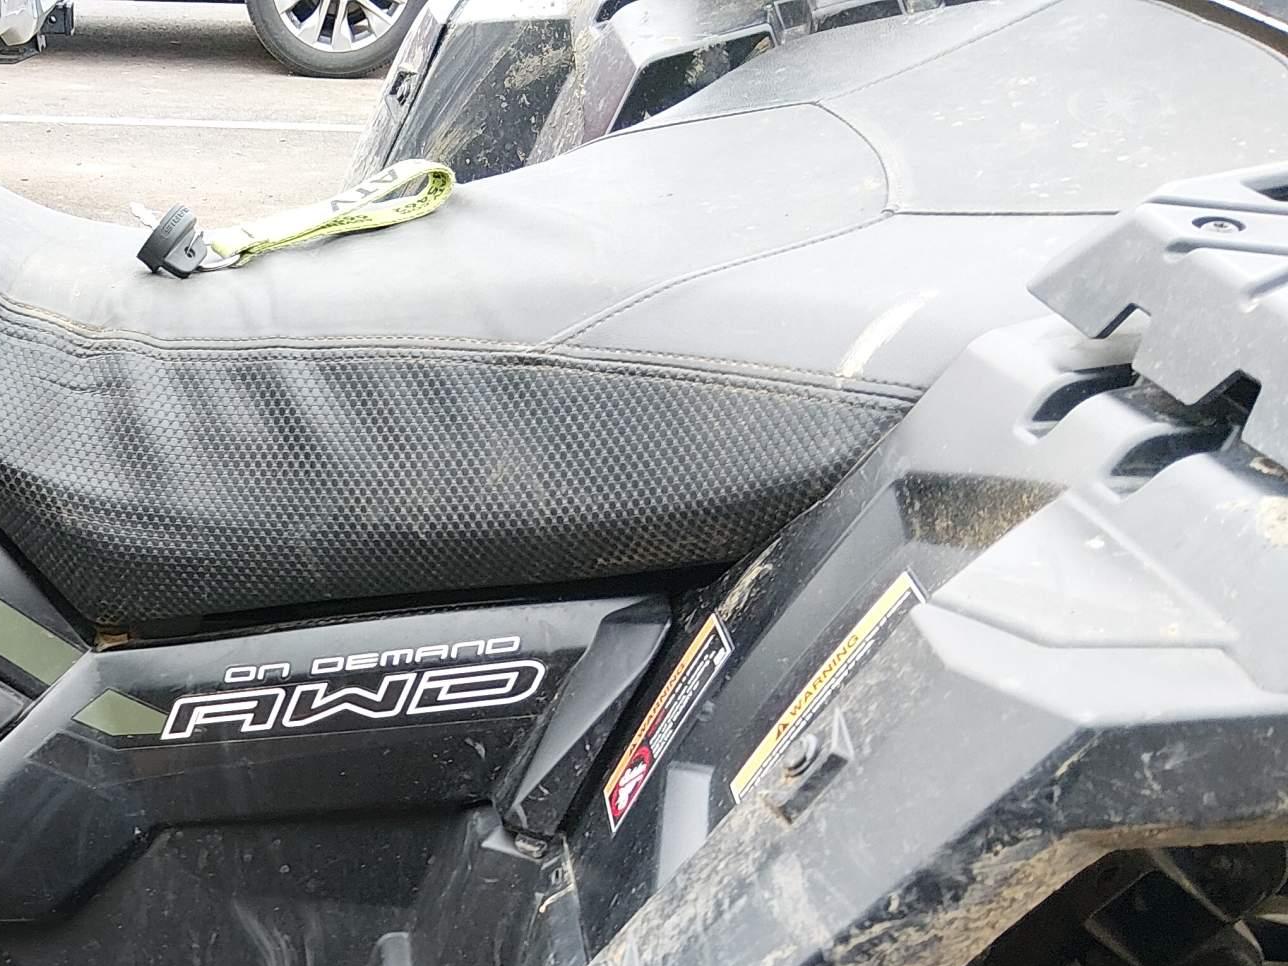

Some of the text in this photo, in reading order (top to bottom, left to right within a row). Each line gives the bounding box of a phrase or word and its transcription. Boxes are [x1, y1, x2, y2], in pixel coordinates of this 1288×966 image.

[330, 168, 399, 212] ATV
[223, 635, 521, 683] ON DEMAND
[791, 633, 860, 716] WARNING
[160, 659, 547, 741] AWD
[638, 662, 685, 739] WARNING
